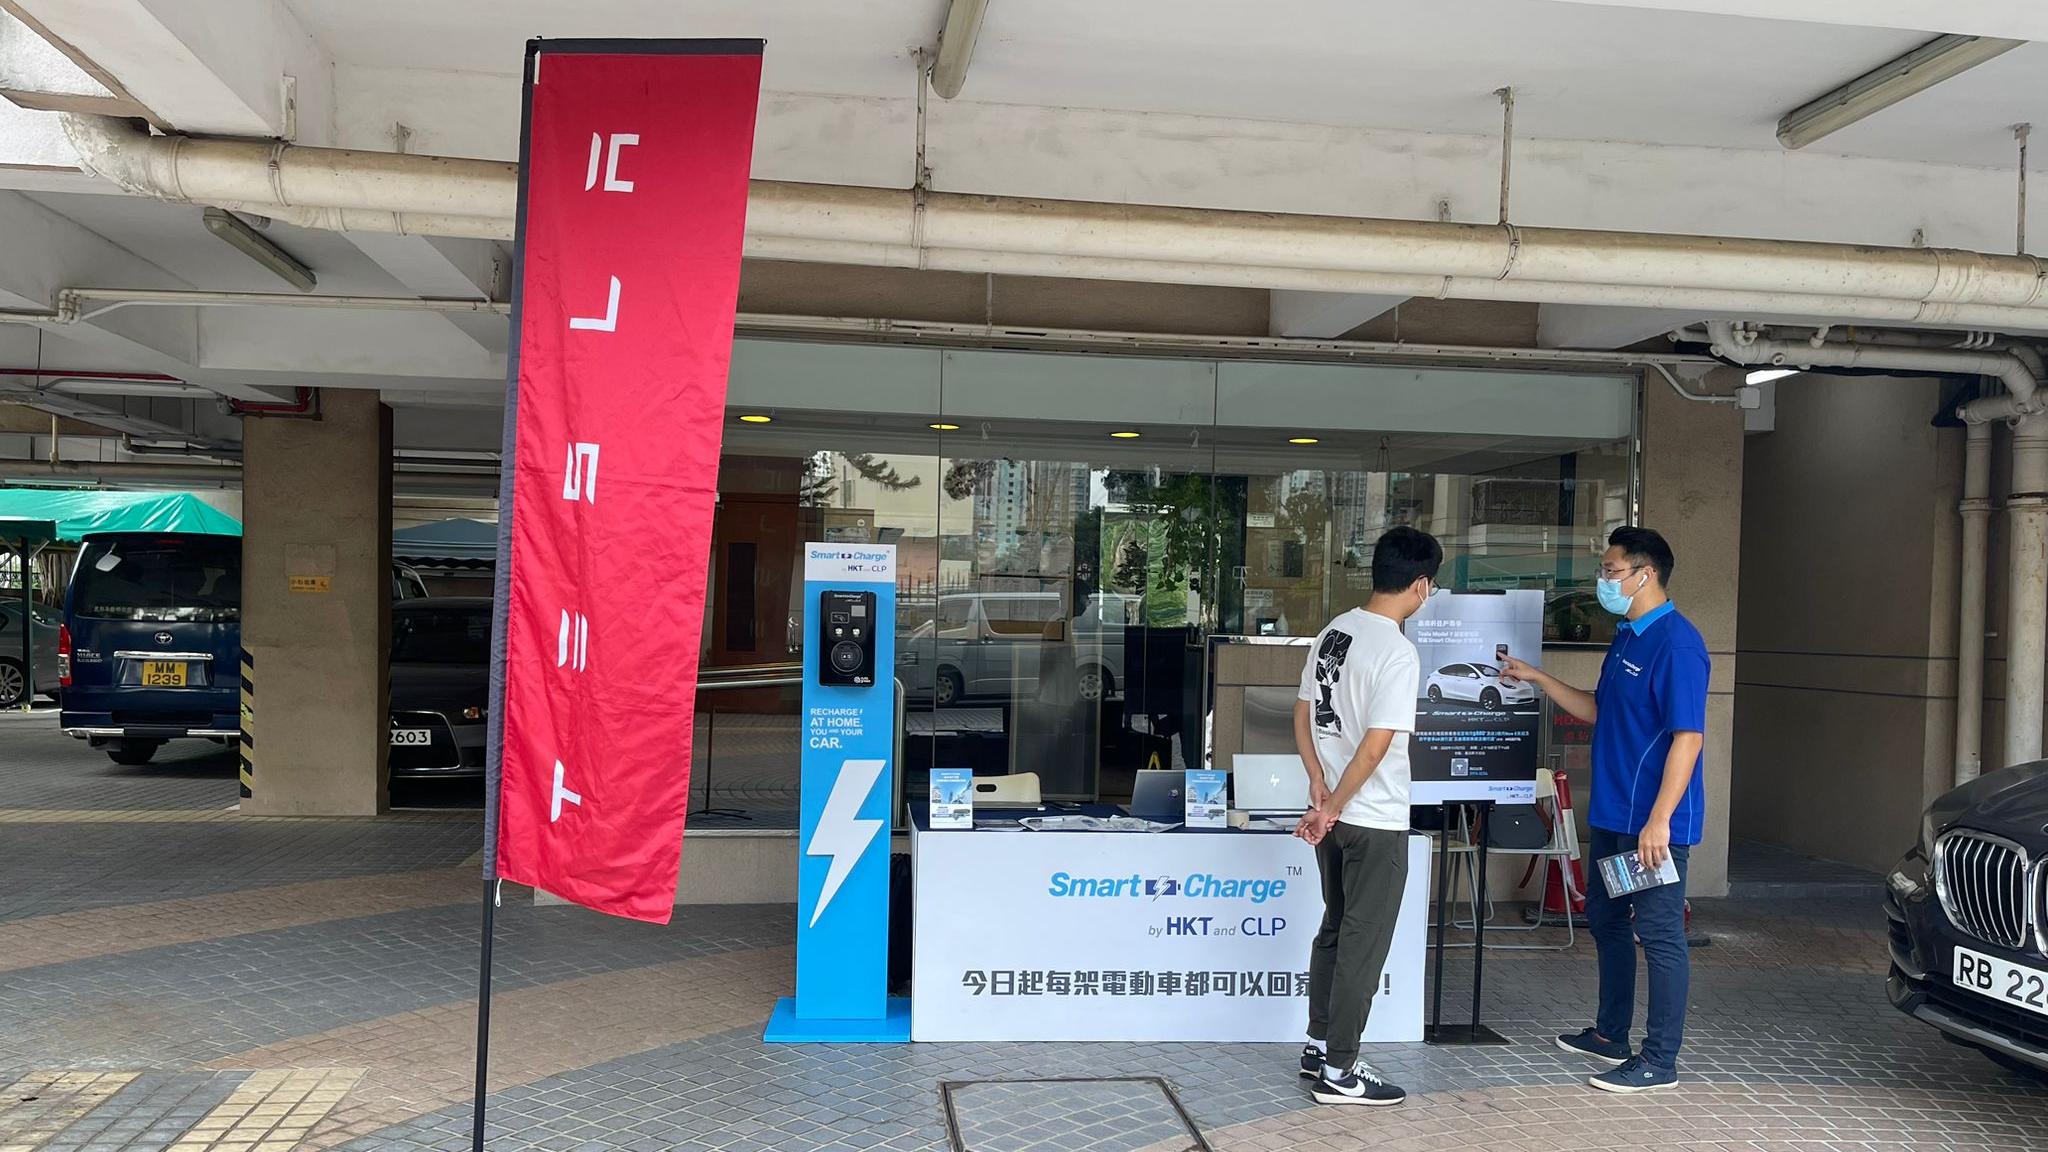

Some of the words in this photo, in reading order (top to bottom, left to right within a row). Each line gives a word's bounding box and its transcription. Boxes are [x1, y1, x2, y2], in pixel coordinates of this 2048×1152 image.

[550, 132, 641, 823] TESLA
[810, 550, 840, 559] Smart
[853, 551, 887, 561] Charge
[155, 663, 176, 673] MM
[147, 674, 182, 685] 1239
[810, 708, 859, 716] RECHARGE
[810, 717, 825, 727] AT
[827, 717, 864, 728] HOME.
[810, 728, 828, 736] YOU
[840, 728, 864, 736] YOUR
[809, 736, 843, 749] CAR.
[1048, 871, 1141, 897] Smart
[1183, 873, 1287, 904] Charge
[1286, 866, 1303, 876] TM
[1148, 924, 1163, 938] by
[1166, 916, 1214, 936] HKT
[1213, 925, 1236, 937] and
[1240, 916, 1287, 936] CLP
[1960, 952, 1993, 990] RB
[2006, 969, 2048, 1009] 22
